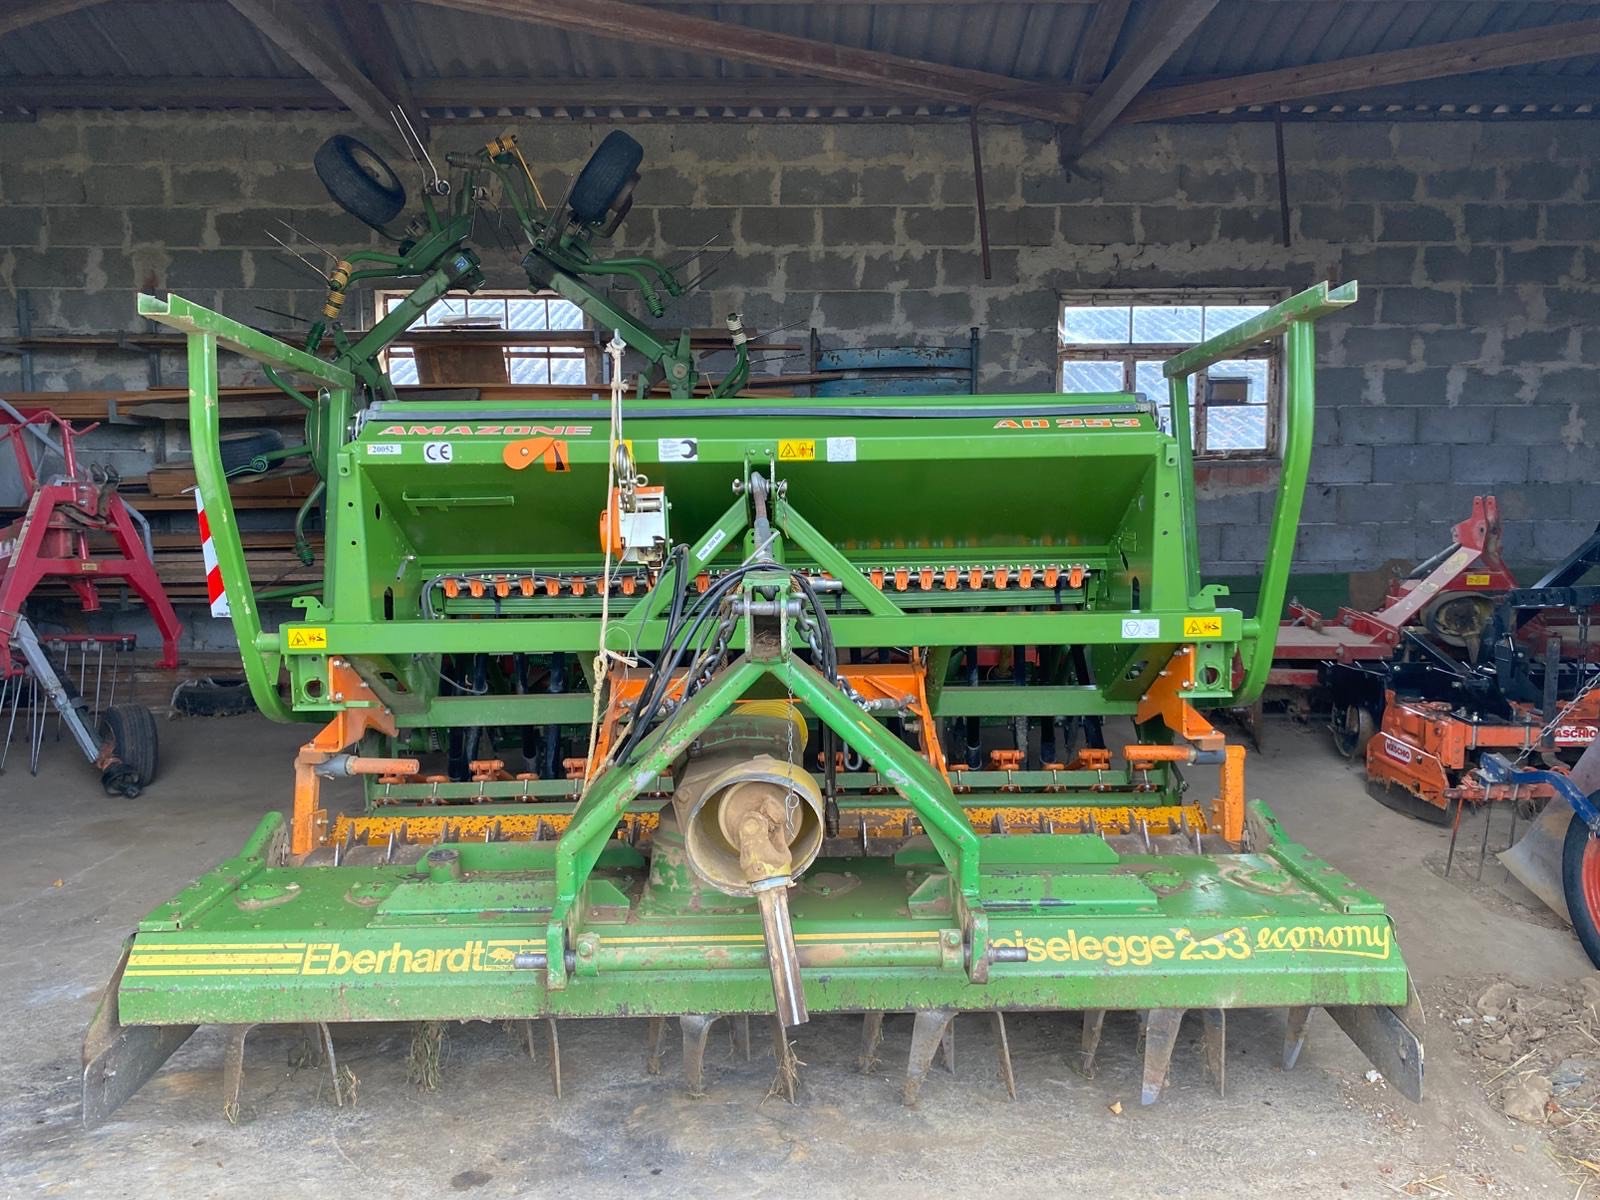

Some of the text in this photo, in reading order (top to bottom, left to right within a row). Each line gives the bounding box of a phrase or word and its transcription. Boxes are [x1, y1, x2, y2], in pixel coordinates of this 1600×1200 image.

[992, 417, 1142, 429] AD 253
[377, 425, 593, 436] AMAZONE
[426, 444, 450, 461] CE
[1555, 728, 1597, 738] ASCHIO
[989, 929, 1175, 967] iselegge
[1253, 925, 1391, 960] economy
[301, 940, 486, 975] Eberhardt
